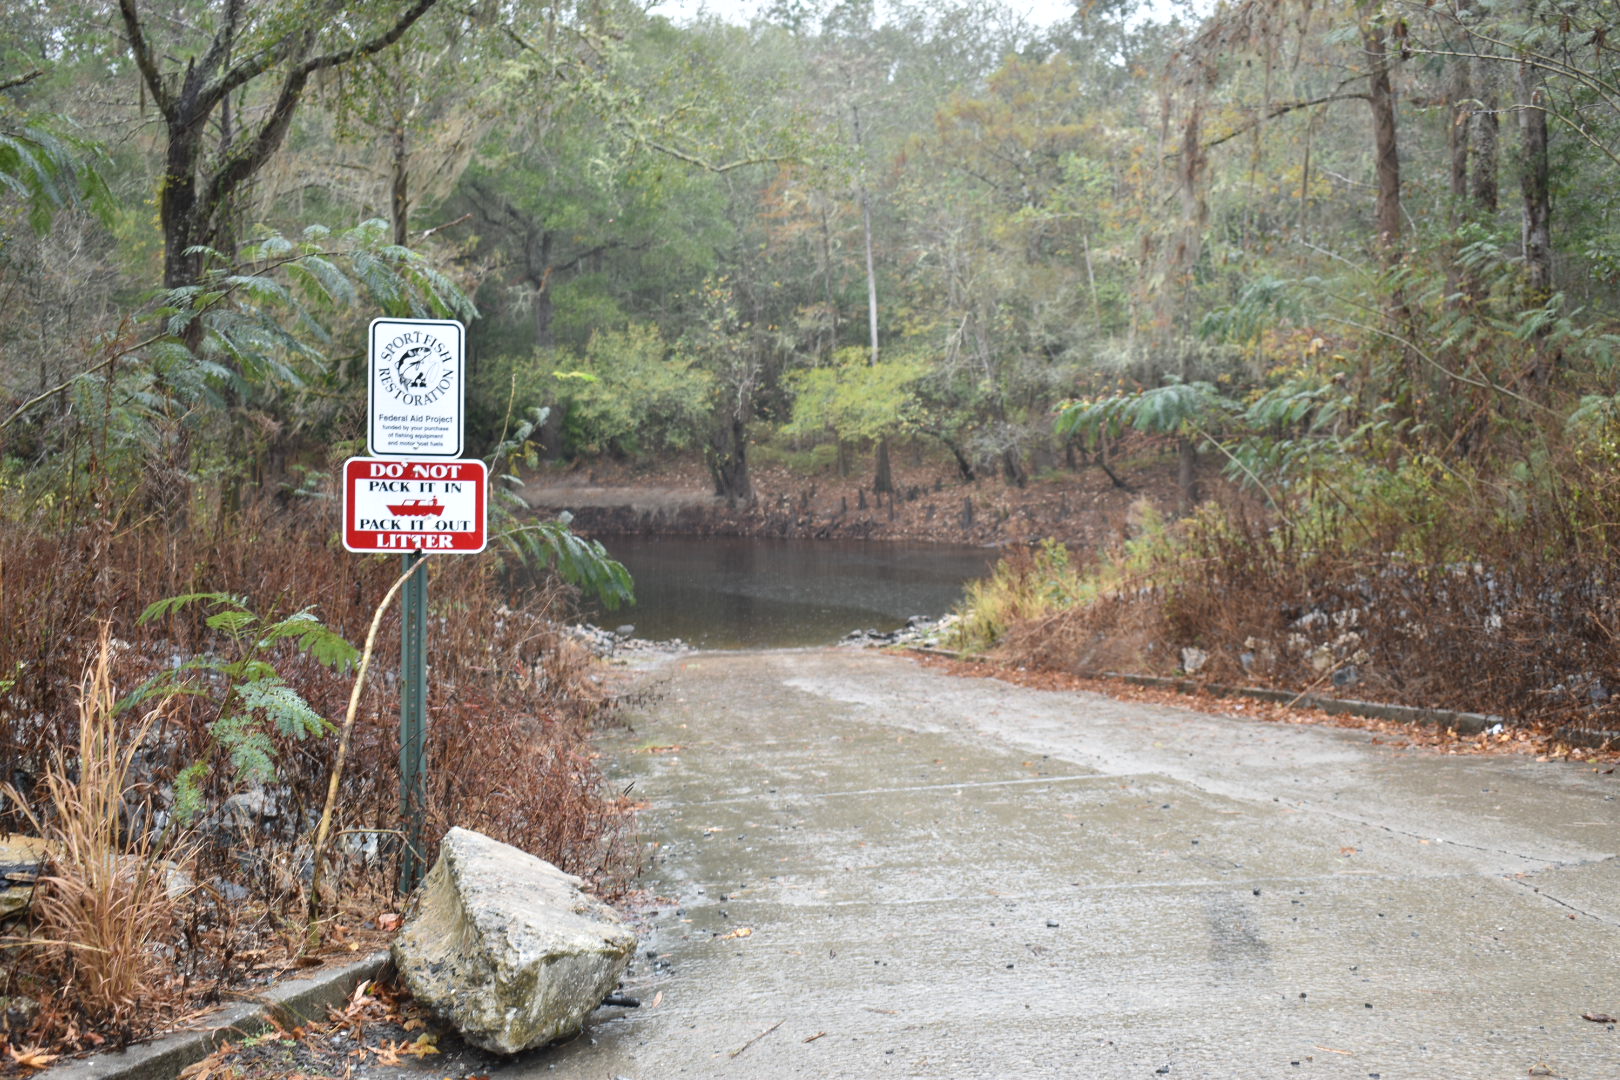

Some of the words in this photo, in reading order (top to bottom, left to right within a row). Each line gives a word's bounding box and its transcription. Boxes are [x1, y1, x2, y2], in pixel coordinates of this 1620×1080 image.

[381, 331, 422, 362] SPORT
[424, 334, 452, 362] FISH
[379, 368, 454, 406] RESTORATION
[379, 414, 408, 422] Federal
[426, 416, 452, 424] Project
[370, 463, 404, 477] DO
[414, 464, 462, 478] NOT
[369, 481, 410, 492] PACK
[420, 482, 436, 492] IT
[445, 483, 462, 493] IN
[360, 519, 400, 530] PACK
[411, 520, 426, 530] IT
[435, 520, 471, 531] OUT
[376, 534, 454, 548] LITTER
